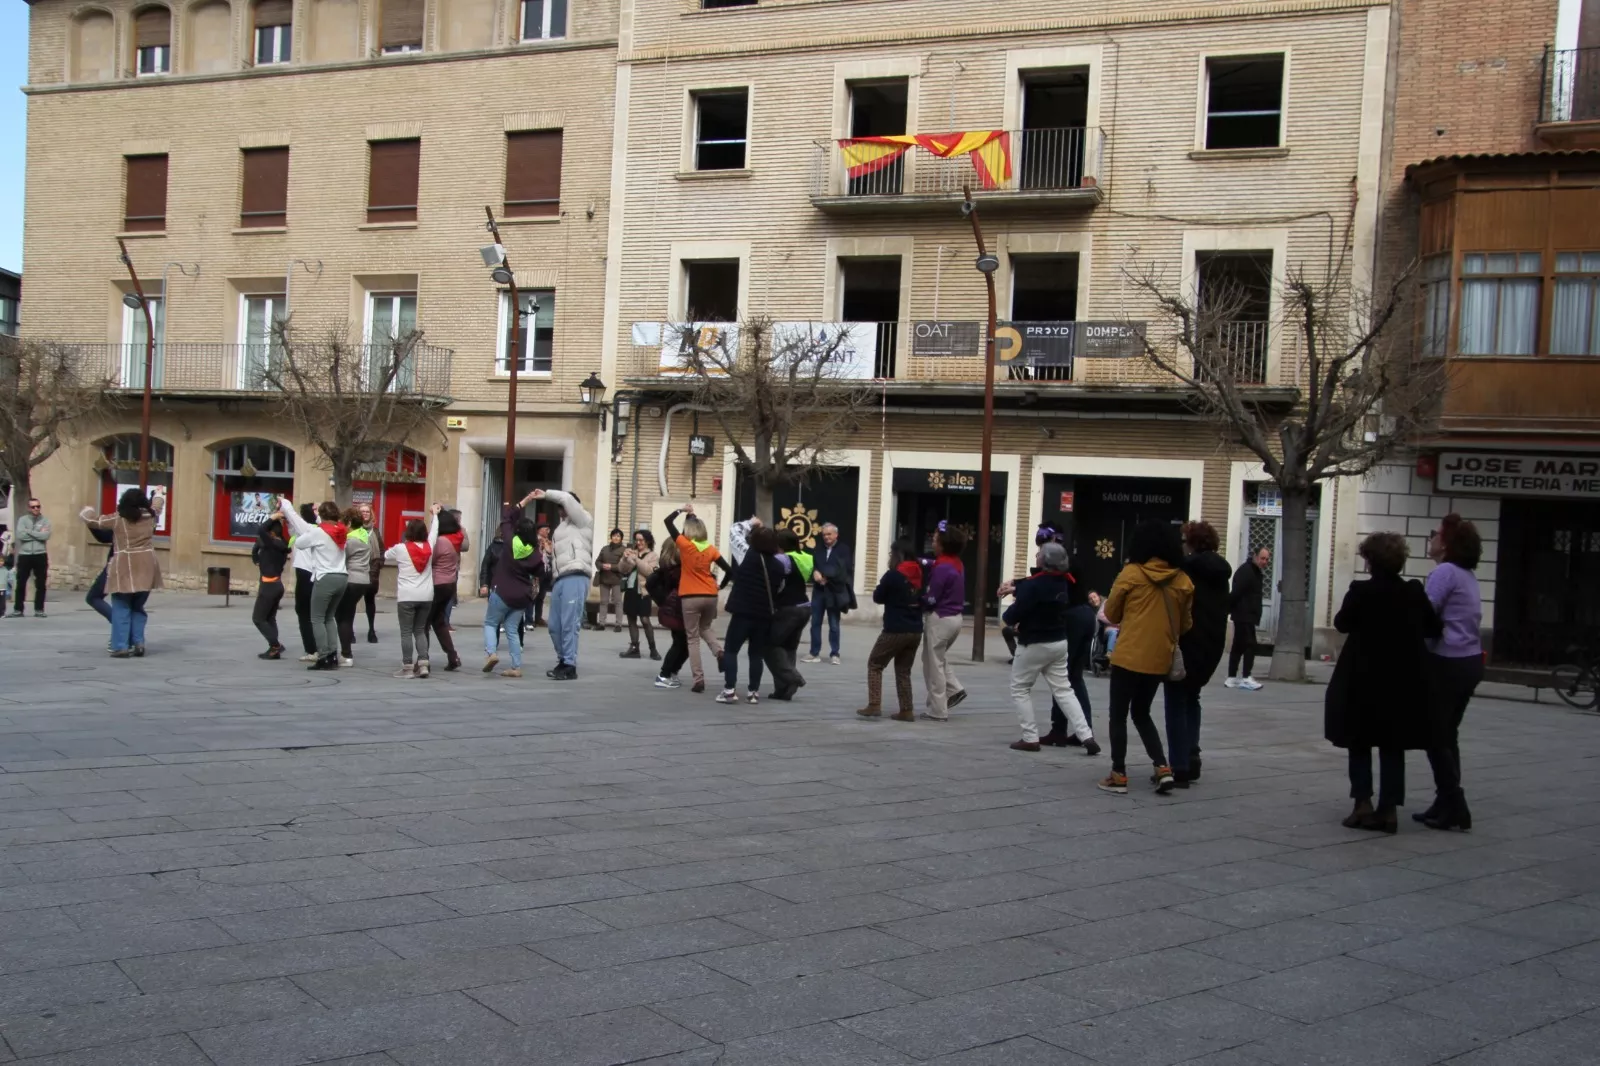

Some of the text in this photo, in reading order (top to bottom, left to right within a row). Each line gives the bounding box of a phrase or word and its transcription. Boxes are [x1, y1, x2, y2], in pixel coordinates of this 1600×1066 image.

[915, 323, 953, 338] OAT
[1445, 457, 1522, 474] JOSE
[948, 472, 975, 485] alea
[1451, 474, 1561, 491] FERRETERIA
[1132, 493, 1143, 502] DE
[1144, 494, 1172, 504] JUEGO
